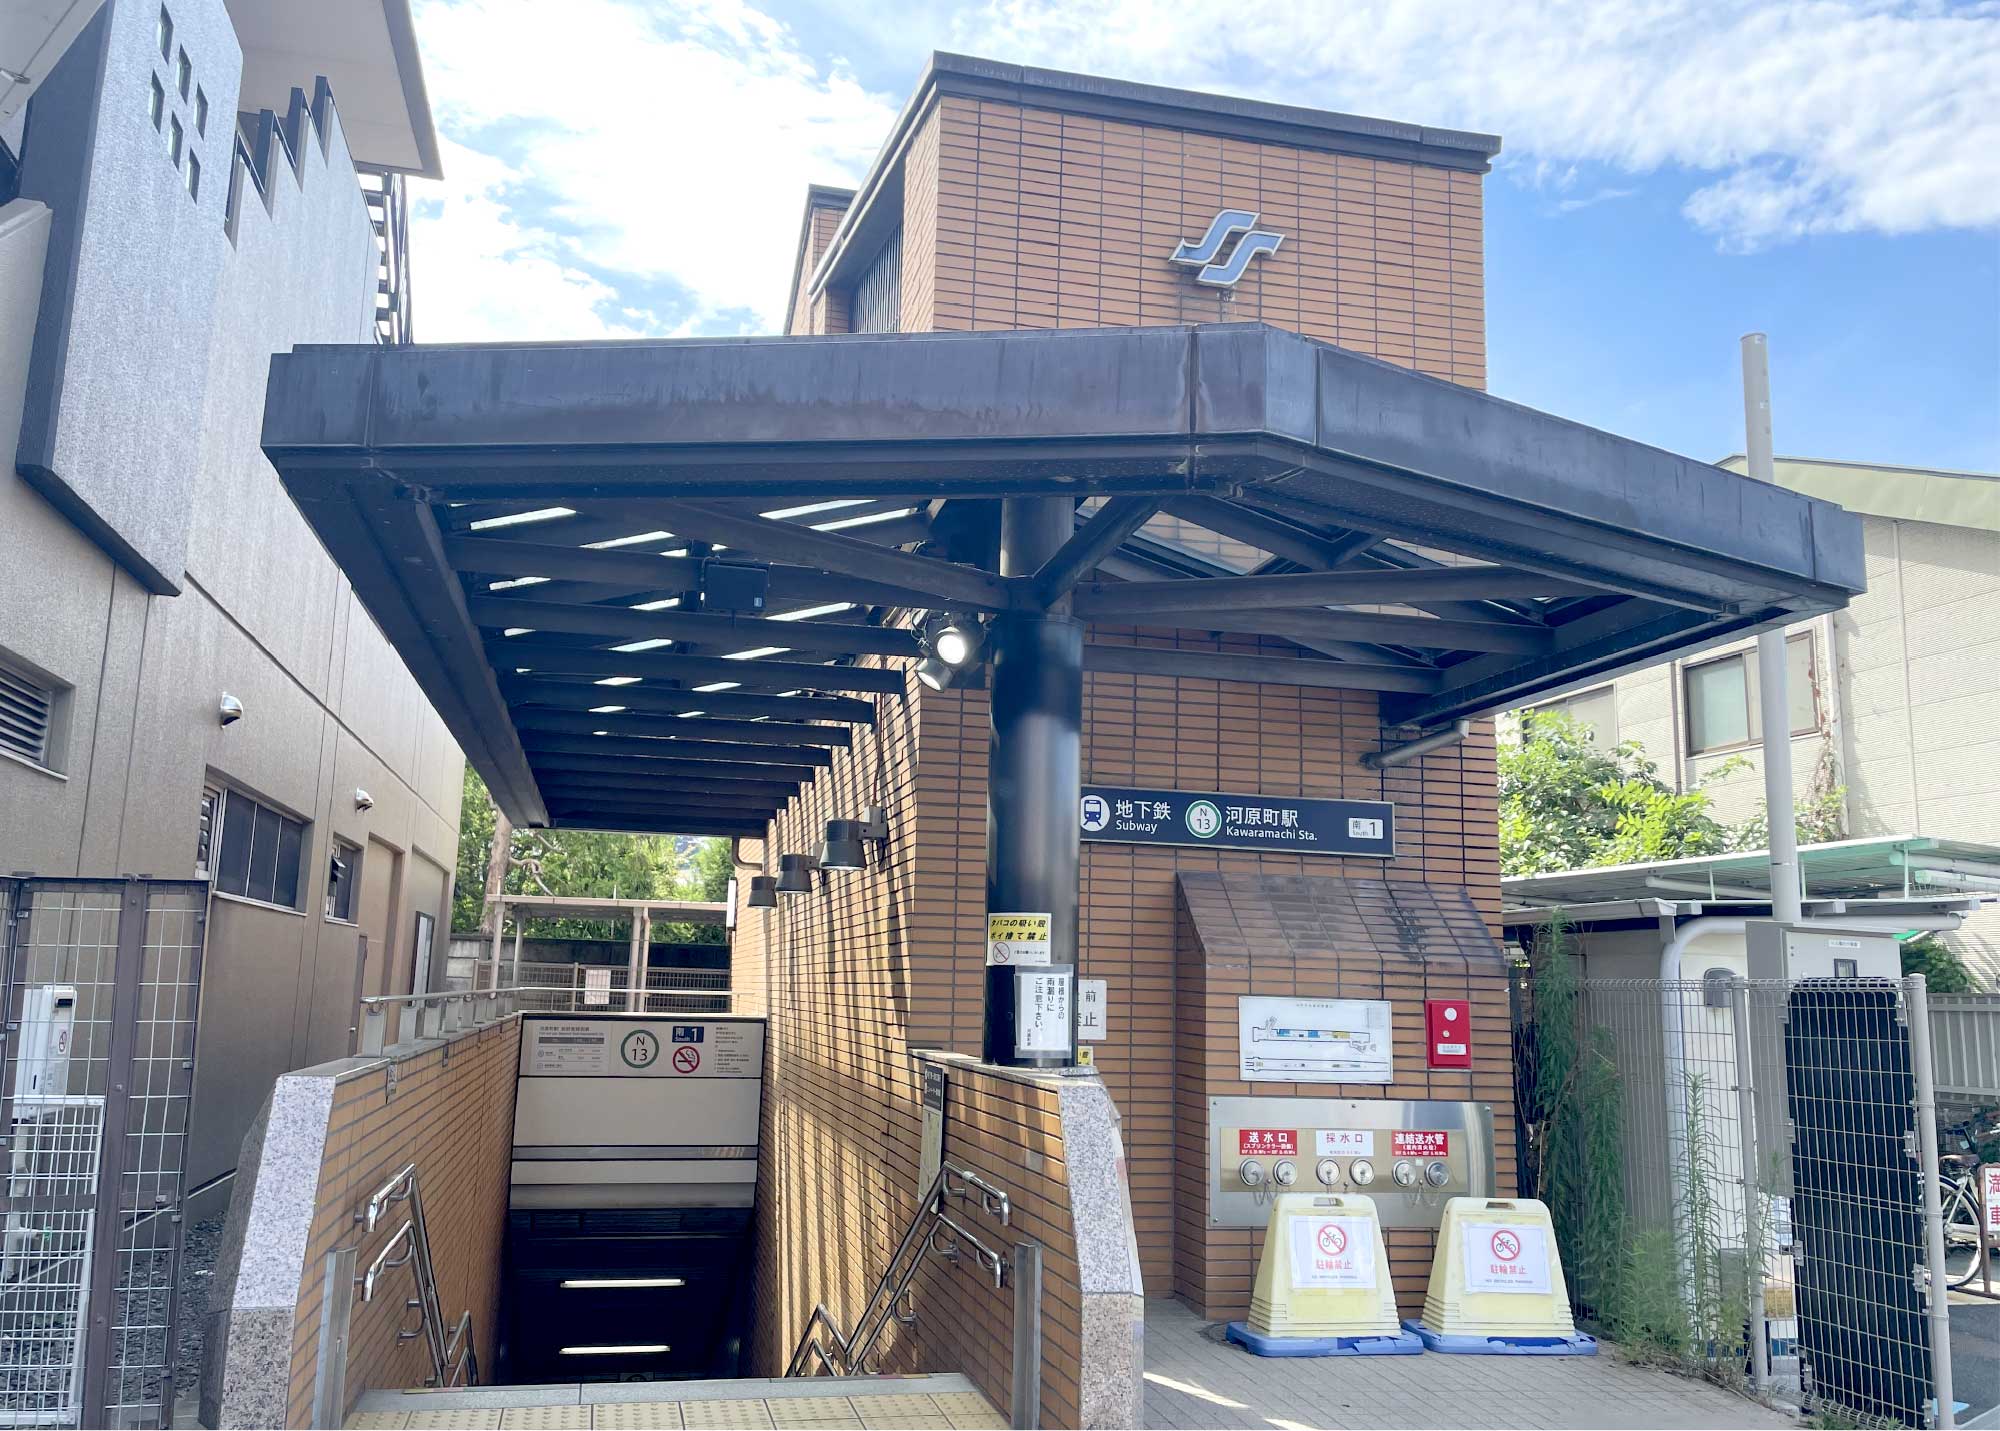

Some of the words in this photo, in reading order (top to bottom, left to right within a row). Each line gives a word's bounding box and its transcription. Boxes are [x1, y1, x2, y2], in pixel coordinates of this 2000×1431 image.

[1115, 799, 1171, 821] 地下鉄
[1200, 808, 1207, 816] N
[1225, 806, 1299, 828] 河原町駅
[1115, 820, 1158, 834] Subway
[1196, 818, 1210, 830] 13
[1352, 819, 1361, 830] 南
[1369, 821, 1376, 837] 1
[1226, 826, 1296, 840] Kawaramachi
[1298, 829, 1318, 841] Sta.
[691, 1027, 698, 1042] 1
[636, 1036, 645, 1046] N
[631, 1048, 649, 1061] 13
[1248, 1131, 1288, 1143] 送水口
[1394, 1133, 1445, 1145] 連結送水管
[1316, 1258, 1353, 1270] 駐輪禁止
[1490, 1264, 1528, 1275] 駐輪禁止
